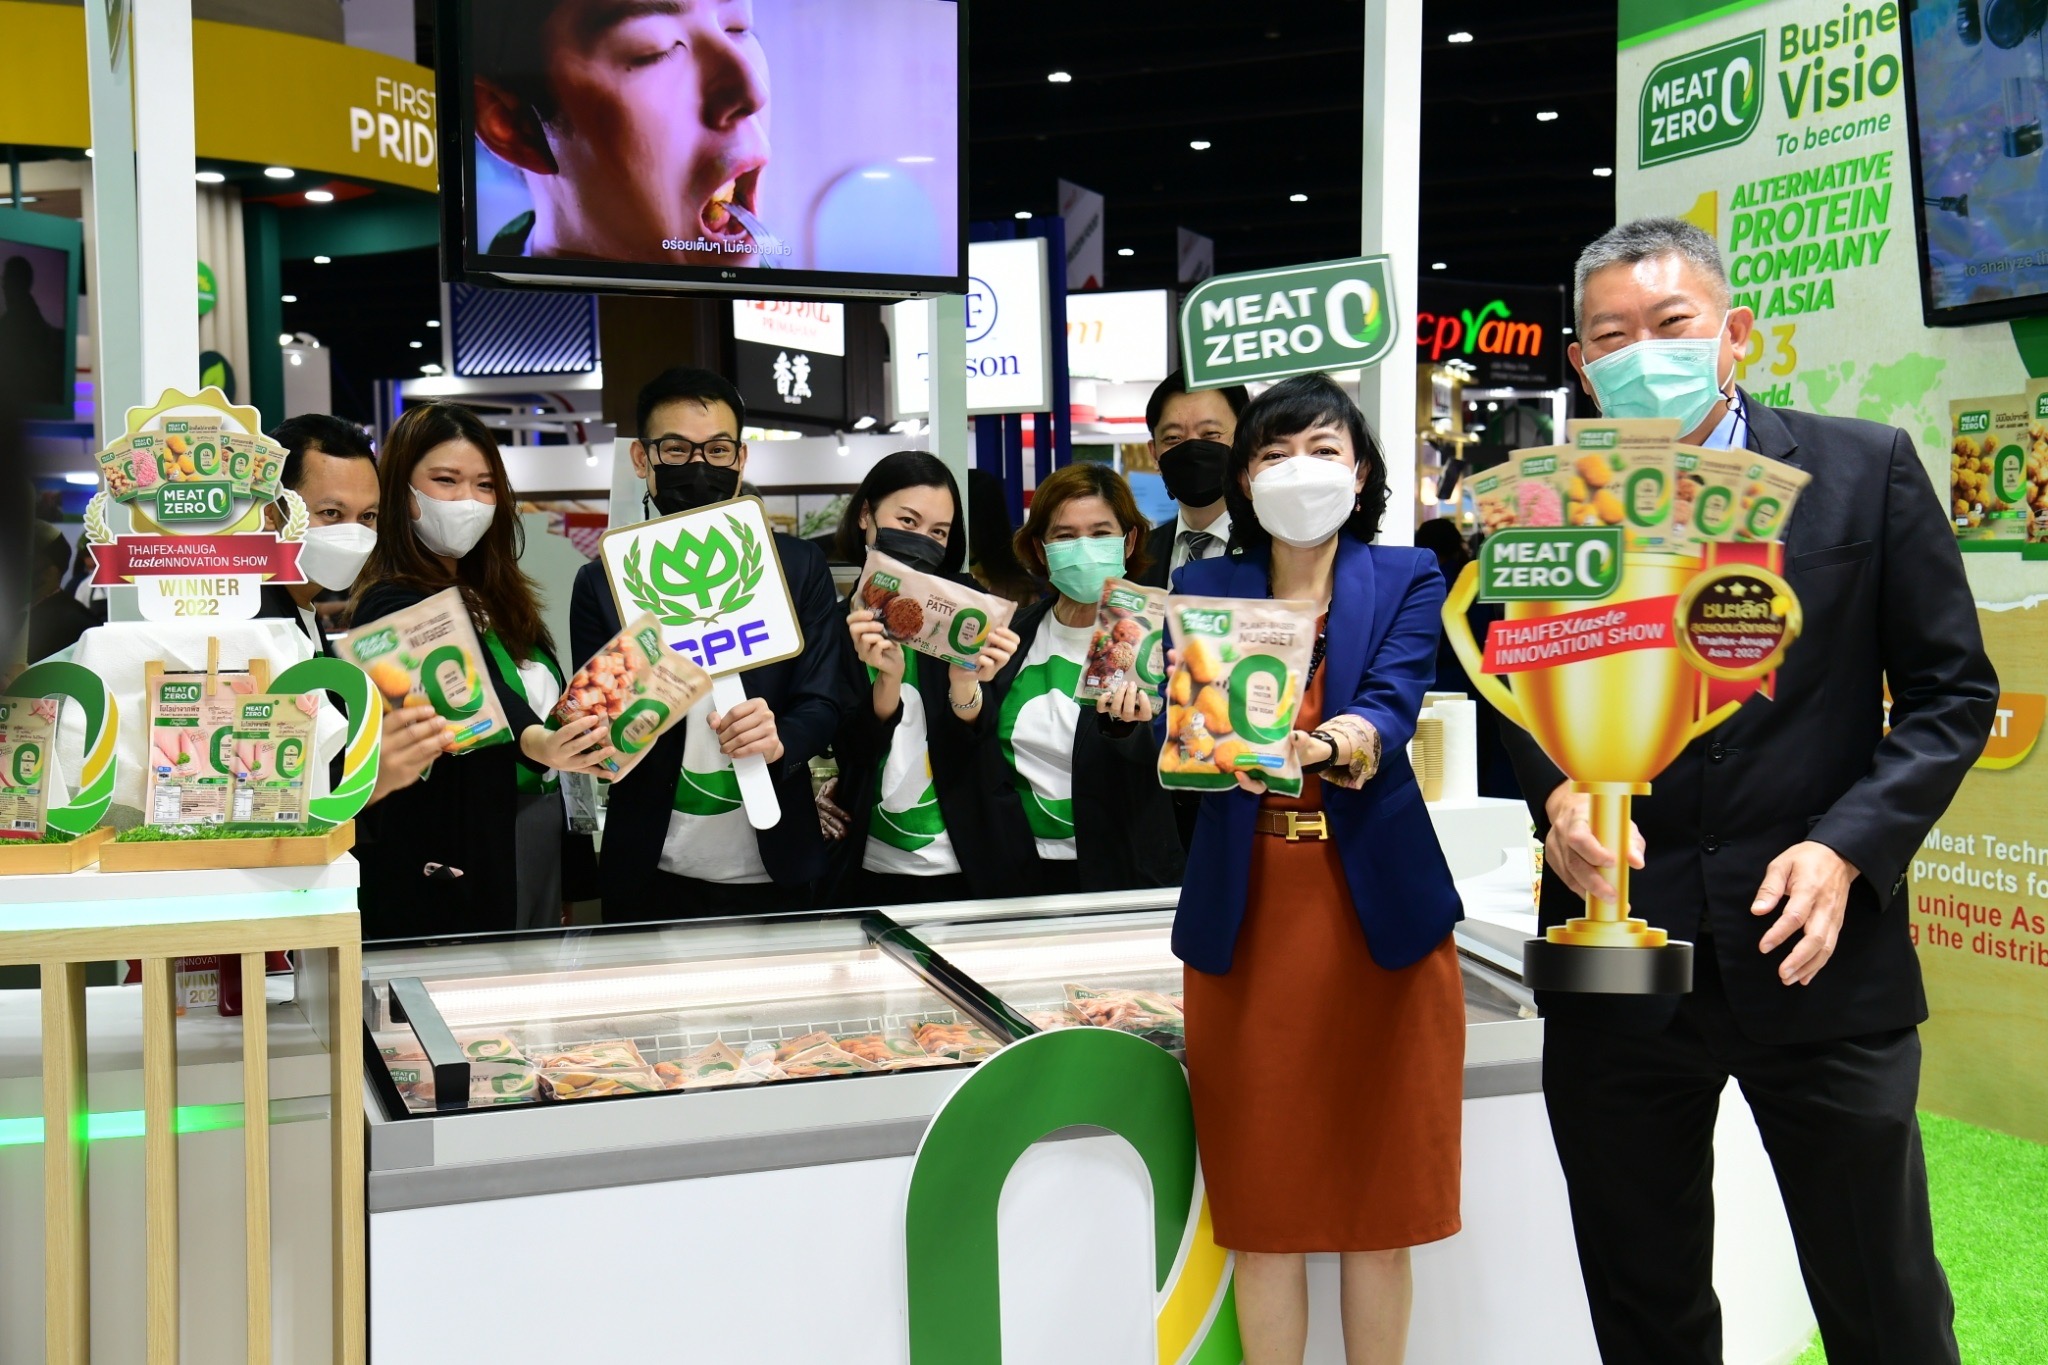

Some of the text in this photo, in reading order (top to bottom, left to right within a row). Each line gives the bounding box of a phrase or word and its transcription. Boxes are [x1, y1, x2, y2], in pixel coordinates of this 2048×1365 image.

[1651, 68, 1717, 113] MEAT
[350, 107, 438, 168] PRID
[1651, 107, 1717, 146] ZERO
[1776, 114, 1890, 156] To become
[1729, 151, 1892, 211] ALTERNATIVE
[1729, 182, 1892, 252] PROTEIN
[662, 236, 721, 255] อร่อยเต็มๆ
[1730, 229, 1891, 287] COMPANY
[1200, 286, 1318, 332] MEAT
[1764, 279, 1835, 319] ASIA
[1203, 324, 1324, 368] ZERO
[917, 351, 1020, 381] Tson
[1961, 415, 1979, 423] MEAT
[1961, 423, 1979, 431] ZERO
[164, 490, 204, 500] MEAT
[164, 503, 206, 514] ZERO
[127, 544, 217, 557] THAIFEX-ANUGA
[233, 555, 268, 568] SHOW
[1493, 540, 1573, 564] MEAT
[159, 578, 240, 597] WINNER
[1492, 566, 1572, 589] ZERO
[174, 599, 219, 617] 2022
[926, 599, 956, 617] PATTY
[1238, 633, 1296, 646] NUGGET
[1495, 622, 1666, 666] INNOVATION SHOW
[1696, 635, 1775, 649] Thaifex-Anuga
[1707, 647, 1763, 659] Asia 2022
[1924, 828, 2048, 867] Meat Techn
[1913, 858, 2018, 894] products
[1917, 894, 2002, 928] unique
[1927, 922, 1963, 950] the
